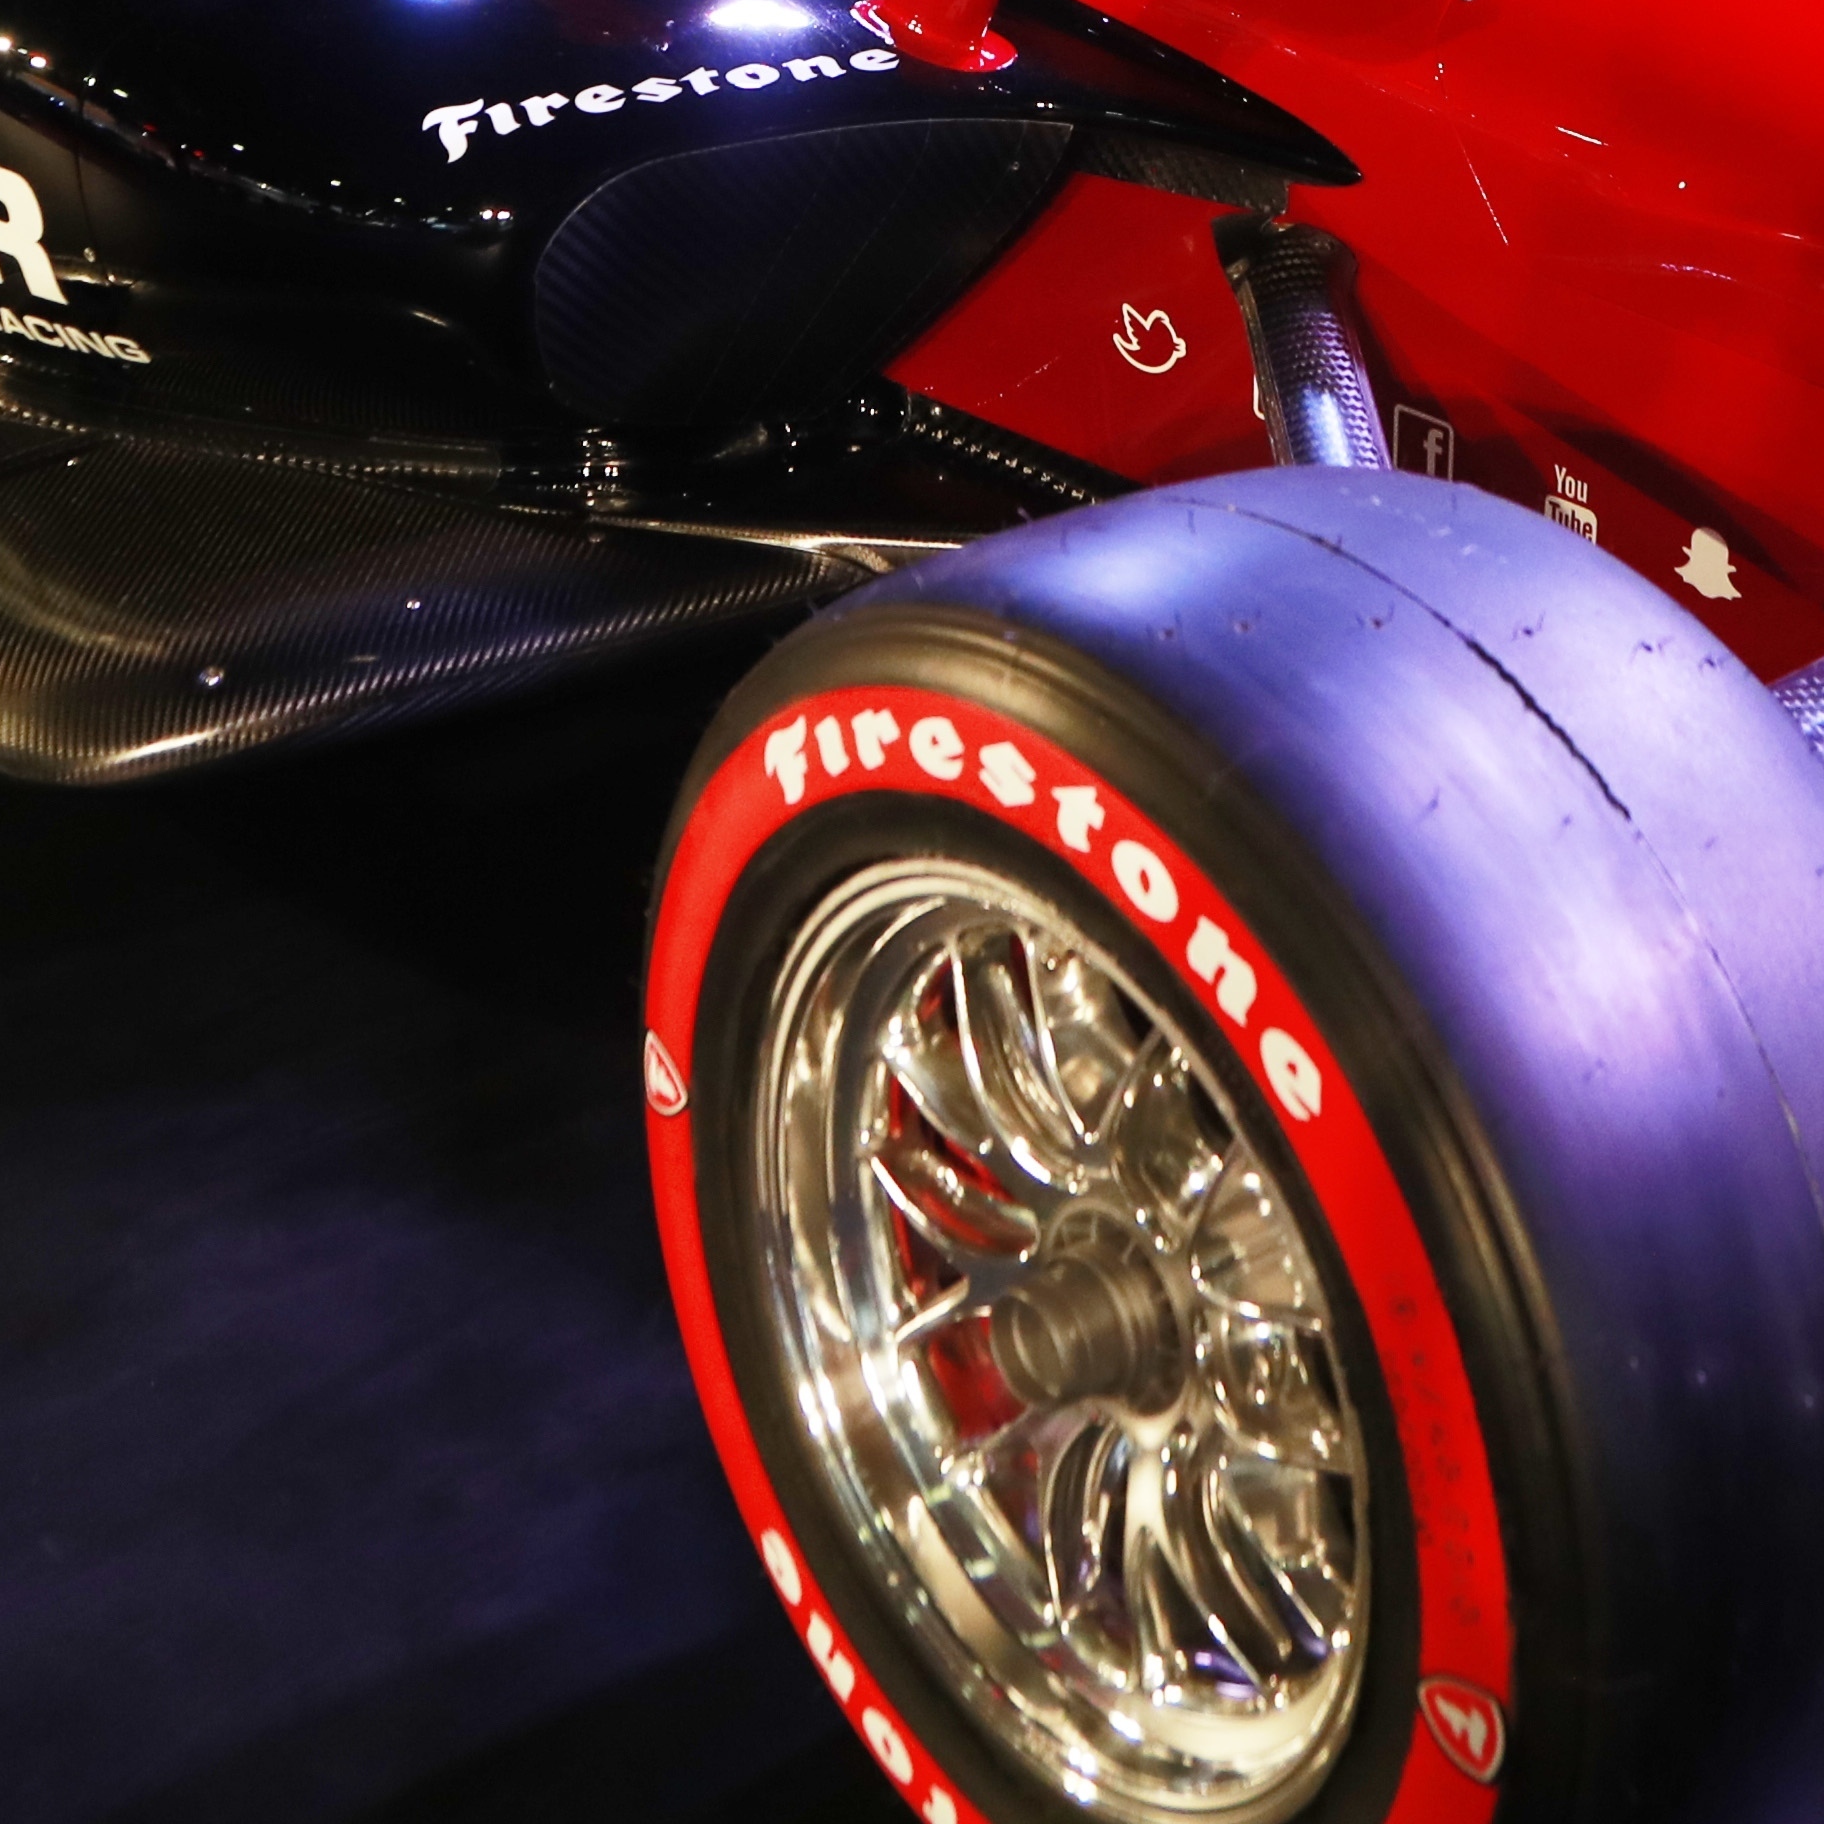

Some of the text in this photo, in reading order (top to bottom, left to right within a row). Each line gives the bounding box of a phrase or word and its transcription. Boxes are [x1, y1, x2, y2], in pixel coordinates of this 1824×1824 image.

[421, 42, 900, 164] Firestone
[1554, 463, 1588, 504] You
[764, 706, 1323, 1123] Firestone
